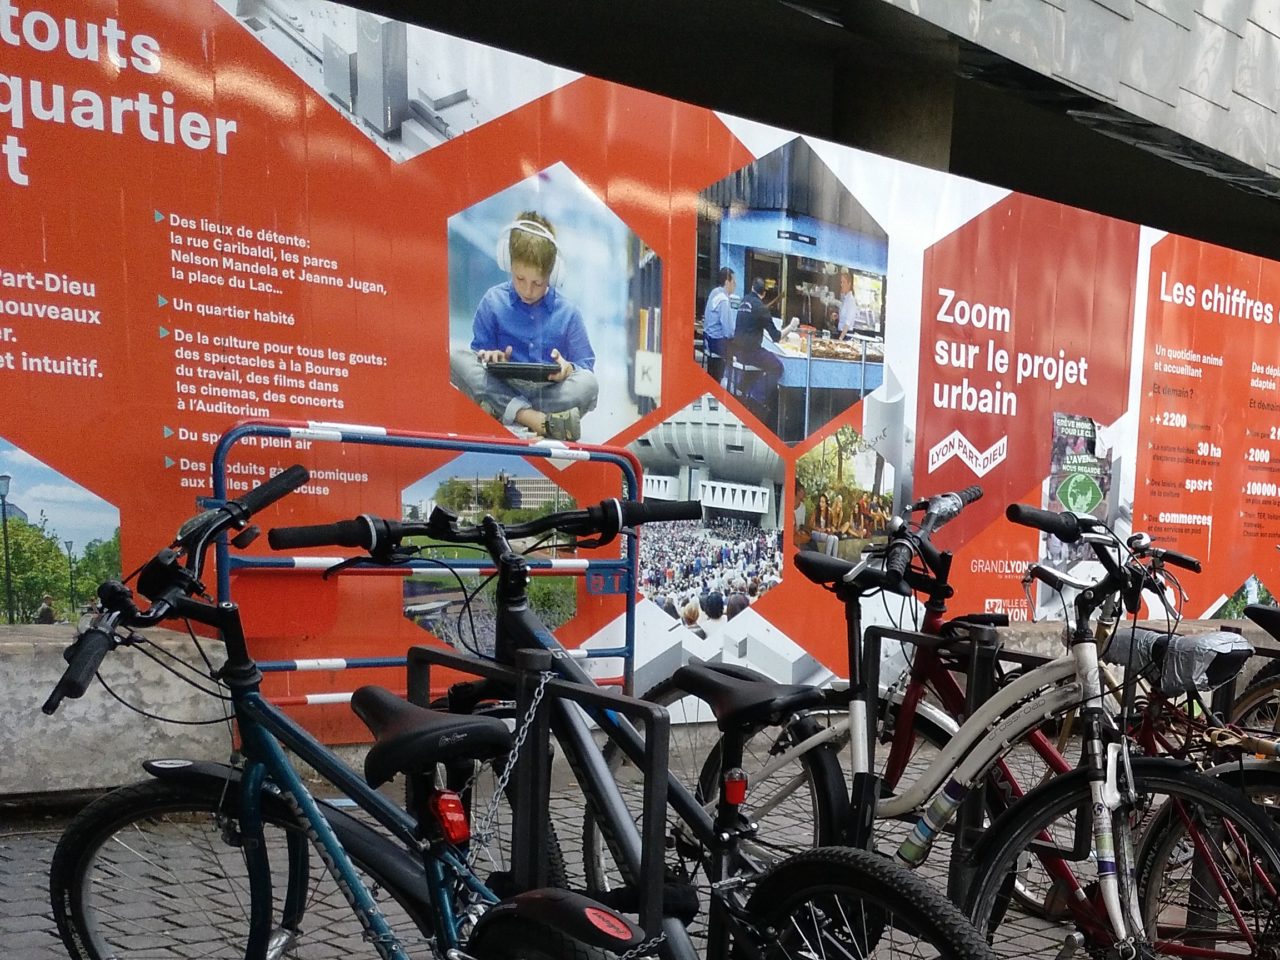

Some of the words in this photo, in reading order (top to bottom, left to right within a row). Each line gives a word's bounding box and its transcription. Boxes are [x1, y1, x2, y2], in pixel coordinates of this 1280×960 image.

[0, 2, 162, 75] touts
[0, 72, 238, 155] quartier
[170, 213, 196, 229] Des
[201, 219, 232, 235] lieux
[237, 226, 252, 238] de
[257, 228, 310, 248] détente:
[171, 232, 183, 244] la
[187, 236, 209, 248] rue
[213, 238, 277, 261] Garibaldi,
[281, 250, 299, 263] les
[303, 255, 337, 270] parcs
[171, 249, 218, 268] Nelson
[223, 257, 278, 277] Mandela
[282, 267, 295, 279] et
[299, 269, 343, 287] Jeanne
[348, 278, 388, 295] Jugan,
[172, 267, 184, 279] la
[189, 270, 224, 285] place
[229, 275, 245, 289] du
[250, 278, 283, 294] Lac...
[937, 288, 1010, 332] Zoom
[1160, 271, 1196, 307] Les
[1202, 283, 1273, 324] chiffres
[173, 298, 192, 312] Un
[197, 303, 250, 320] quartier
[254, 307, 295, 325] habité
[174, 329, 193, 343] De
[198, 333, 209, 344] la
[213, 335, 259, 350] culture
[264, 342, 293, 355] pour
[298, 346, 324, 359] tous
[328, 348, 345, 361] les
[349, 350, 387, 366] gouts:
[1156, 344, 1166, 356] Un
[1168, 348, 1200, 363] quotidien
[1202, 354, 1223, 367] animé
[22, 351, 103, 377] intuitif.
[175, 347, 199, 360] des
[204, 350, 274, 369] spectacles
[279, 358, 286, 370] à
[291, 359, 301, 371] la
[306, 362, 348, 377] Bourse
[935, 339, 979, 369] sur
[987, 339, 1009, 374] le
[1017, 349, 1088, 389] projet
[1154, 362, 1162, 370] et
[1163, 362, 1202, 378] accueillant
[1252, 362, 1264, 374] Des
[176, 365, 193, 376] du
[197, 368, 242, 384] travail,
[247, 372, 269, 385] des
[274, 374, 305, 389] films
[309, 378, 339, 392] dans
[1251, 377, 1275, 390] adaptés
[177, 382, 196, 394] les
[201, 384, 259, 401] cinemas,
[263, 390, 286, 402] des
[290, 394, 344, 409] concerts
[177, 398, 185, 410] à
[190, 399, 269, 417] l'Auditorium
[933, 378, 1016, 416] urbain
[179, 428, 198, 441] Du
[241, 436, 256, 445] en
[261, 435, 292, 449] plein
[296, 440, 312, 450] air
[931, 439, 955, 466] LYON
[1198, 442, 1209, 456] 30
[1210, 444, 1222, 458] ha
[180, 458, 205, 471] Des
[211, 460, 265, 475] oduits
[269, 463, 368, 483] ganomiques
[181, 478, 205, 488] aux
[209, 479, 248, 491] lles
[1159, 512, 1212, 526] commerces
[1003, 599, 1018, 607] VILLE
[1020, 599, 1027, 607] DE
